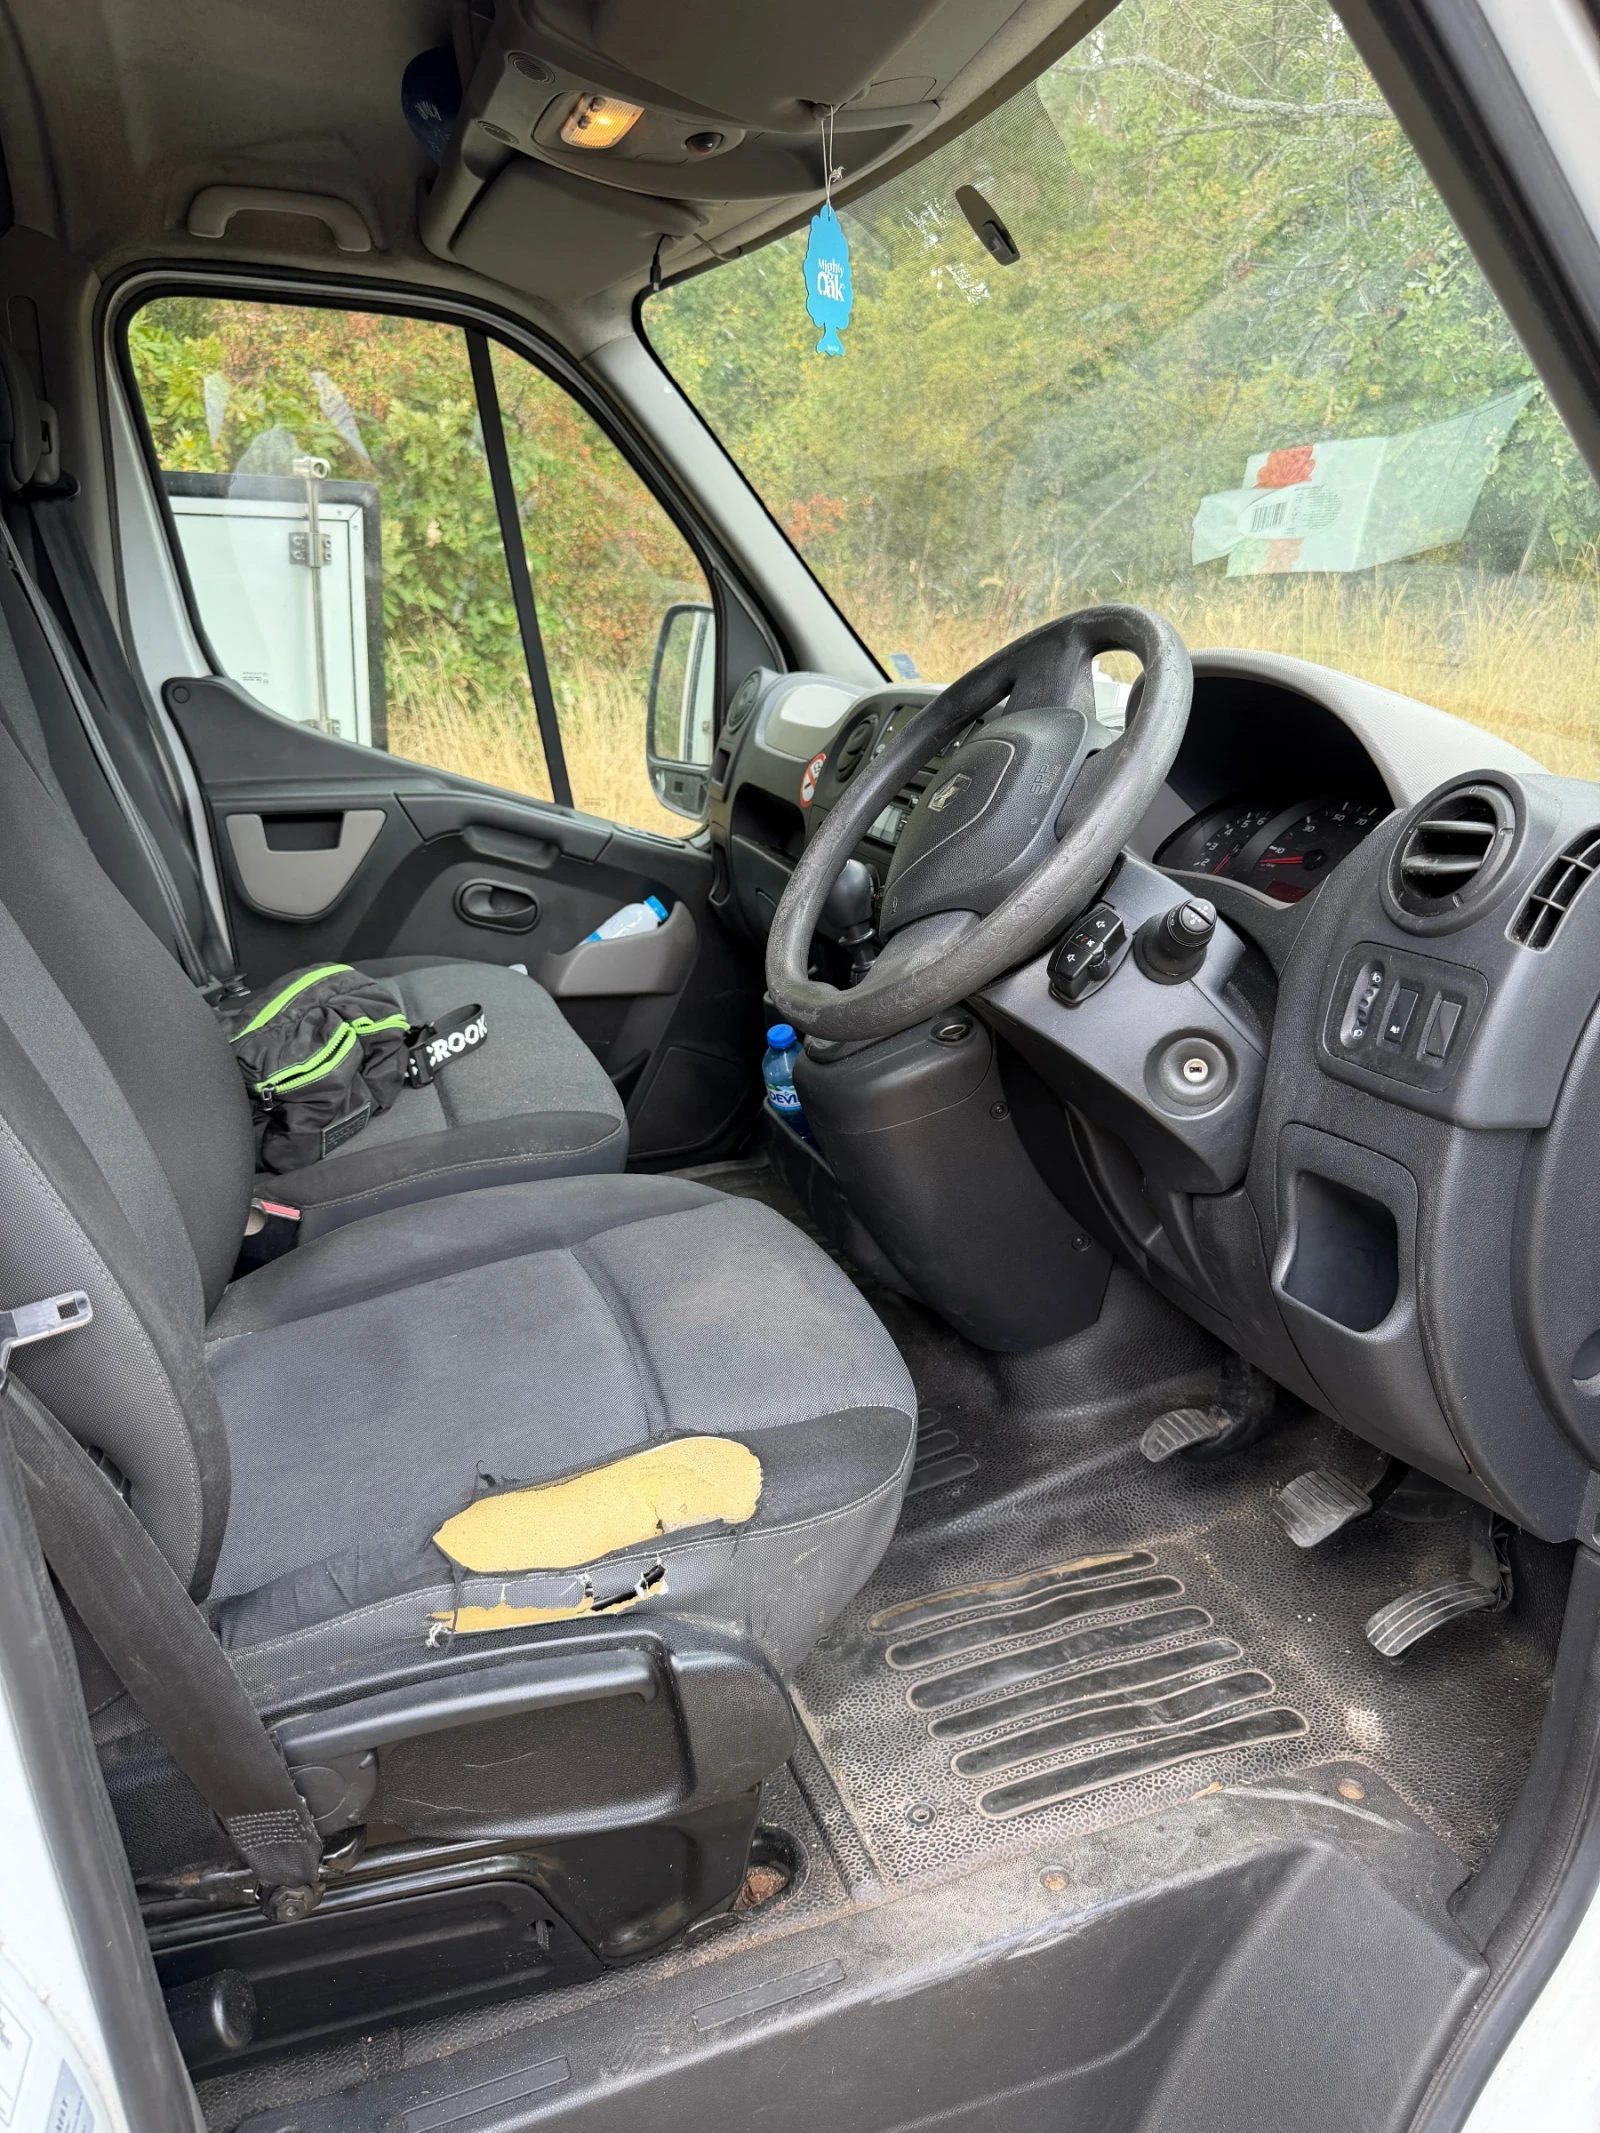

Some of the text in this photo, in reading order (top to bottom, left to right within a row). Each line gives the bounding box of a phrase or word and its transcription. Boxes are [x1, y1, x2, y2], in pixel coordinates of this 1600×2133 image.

[817, 271, 846, 302] Oak
[818, 258, 845, 279] Mighty
[1200, 817, 1267, 867] 2 3 4 5 6
[1275, 813, 1368, 855] 10 30 50 70
